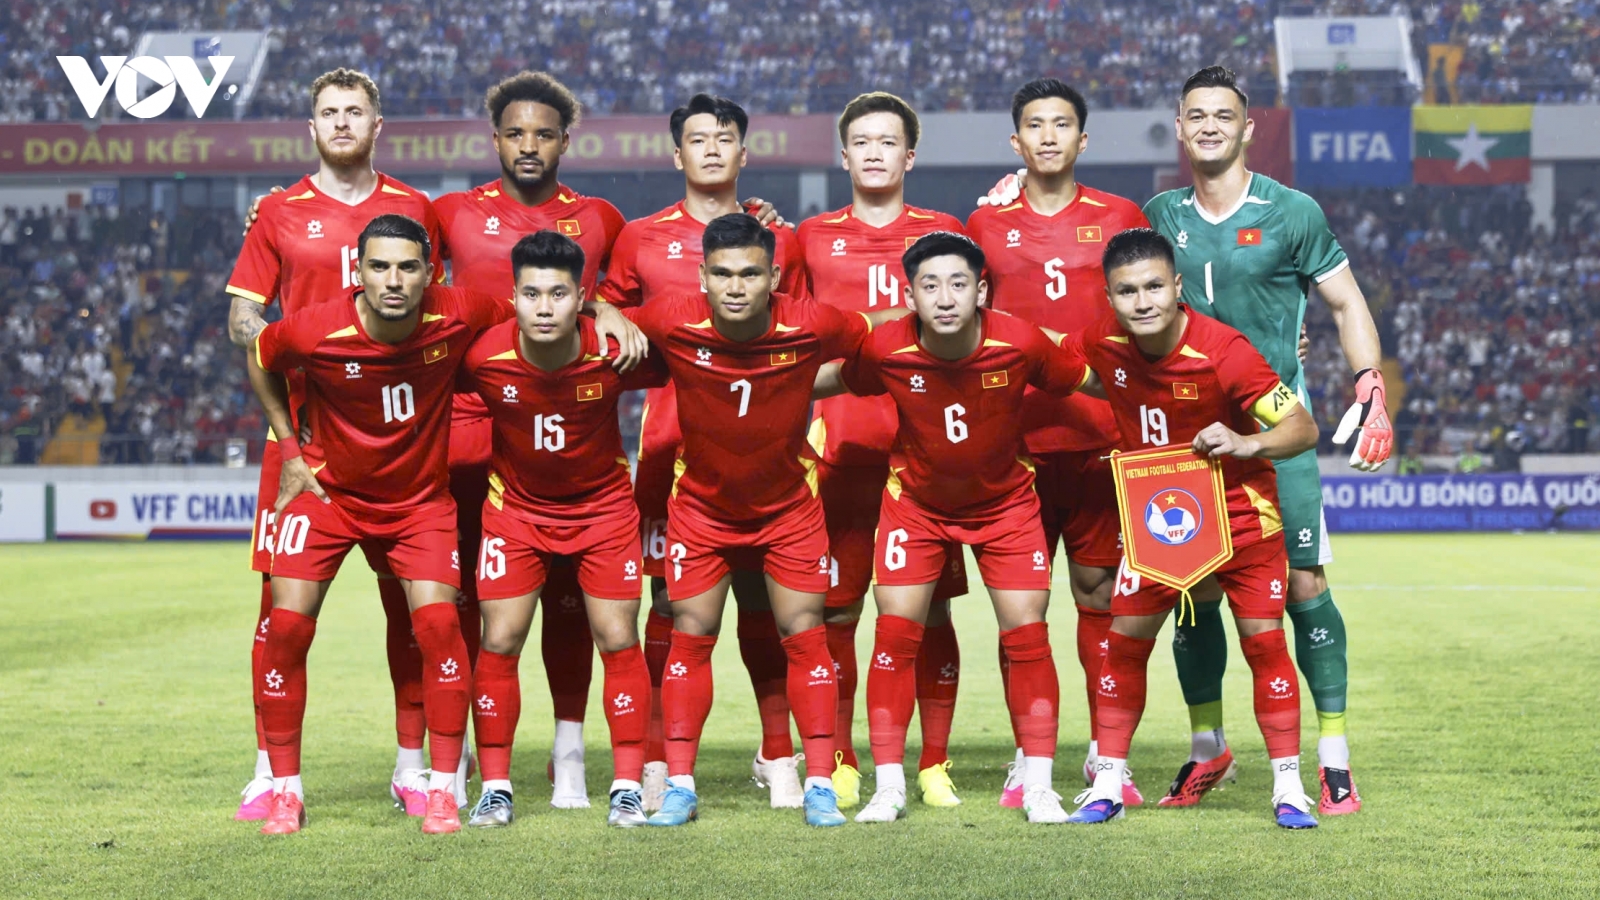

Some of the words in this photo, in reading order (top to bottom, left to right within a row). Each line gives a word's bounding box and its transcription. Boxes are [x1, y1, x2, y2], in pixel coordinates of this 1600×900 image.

[248, 134, 321, 163] TRU
[1310, 130, 1395, 162] FIFA
[868, 264, 899, 307] 14
[1044, 257, 1067, 301] 5
[1204, 261, 1214, 305] 1
[381, 382, 416, 424] 10
[729, 378, 752, 418] 7
[534, 413, 566, 452] 15
[943, 403, 969, 444] 6
[1139, 404, 1170, 447] 19
[1125, 466, 1150, 480] VIETNAM
[1149, 463, 1176, 477] FOOTBALL
[1176, 459, 1209, 473] FEDERATION
[132, 493, 179, 522] VFF
[186, 493, 258, 522] CHAN
[1322, 484, 1357, 509] AO
[1419, 476, 1496, 508] BÓNG
[1543, 473, 1600, 510] QUỐ
[276, 513, 311, 556] 10
[643, 517, 667, 560] 16
[884, 528, 909, 572] 6
[1167, 529, 1186, 538] VFF
[480, 536, 507, 581] 15
[670, 542, 687, 582] 7
